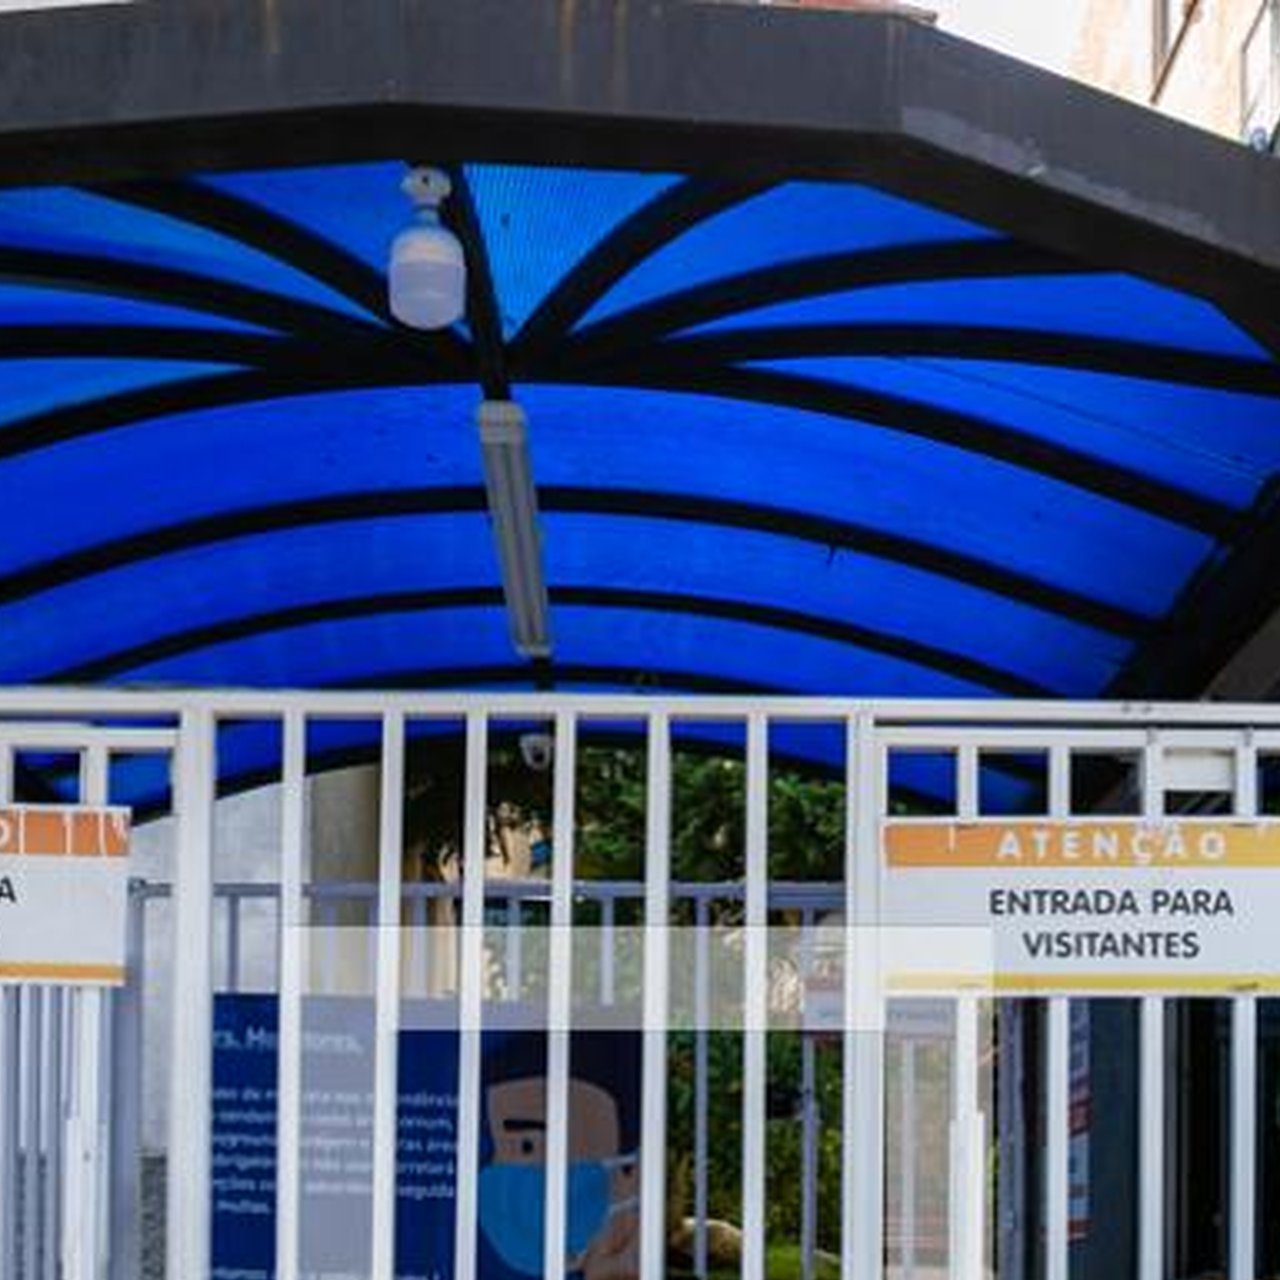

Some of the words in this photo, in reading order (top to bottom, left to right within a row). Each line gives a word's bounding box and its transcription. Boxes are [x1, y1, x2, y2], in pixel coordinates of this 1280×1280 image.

[996, 825, 1229, 866] ATENÇÃO
[989, 888, 1139, 916] ENTRADA
[1151, 889, 1234, 916] PARA
[1022, 931, 1201, 959] VISITANTES
